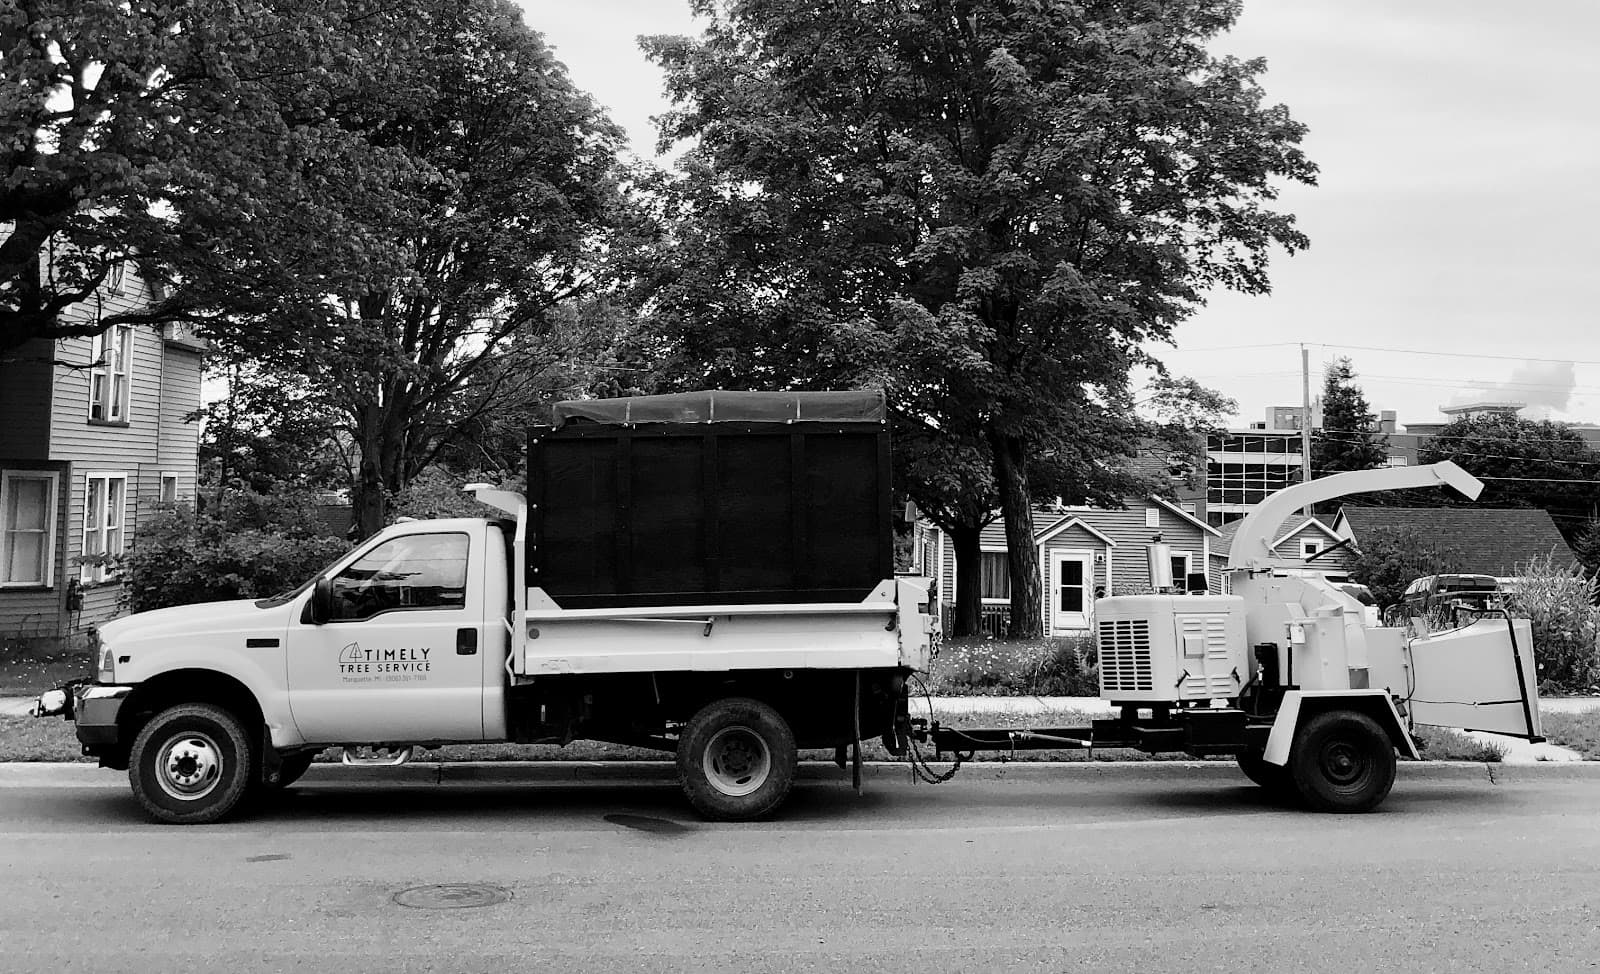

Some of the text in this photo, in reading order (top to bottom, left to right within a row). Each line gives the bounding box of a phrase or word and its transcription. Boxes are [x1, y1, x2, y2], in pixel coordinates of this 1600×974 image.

[364, 648, 430, 661] TIMELY
[340, 663, 431, 673] TREE SERVICE
